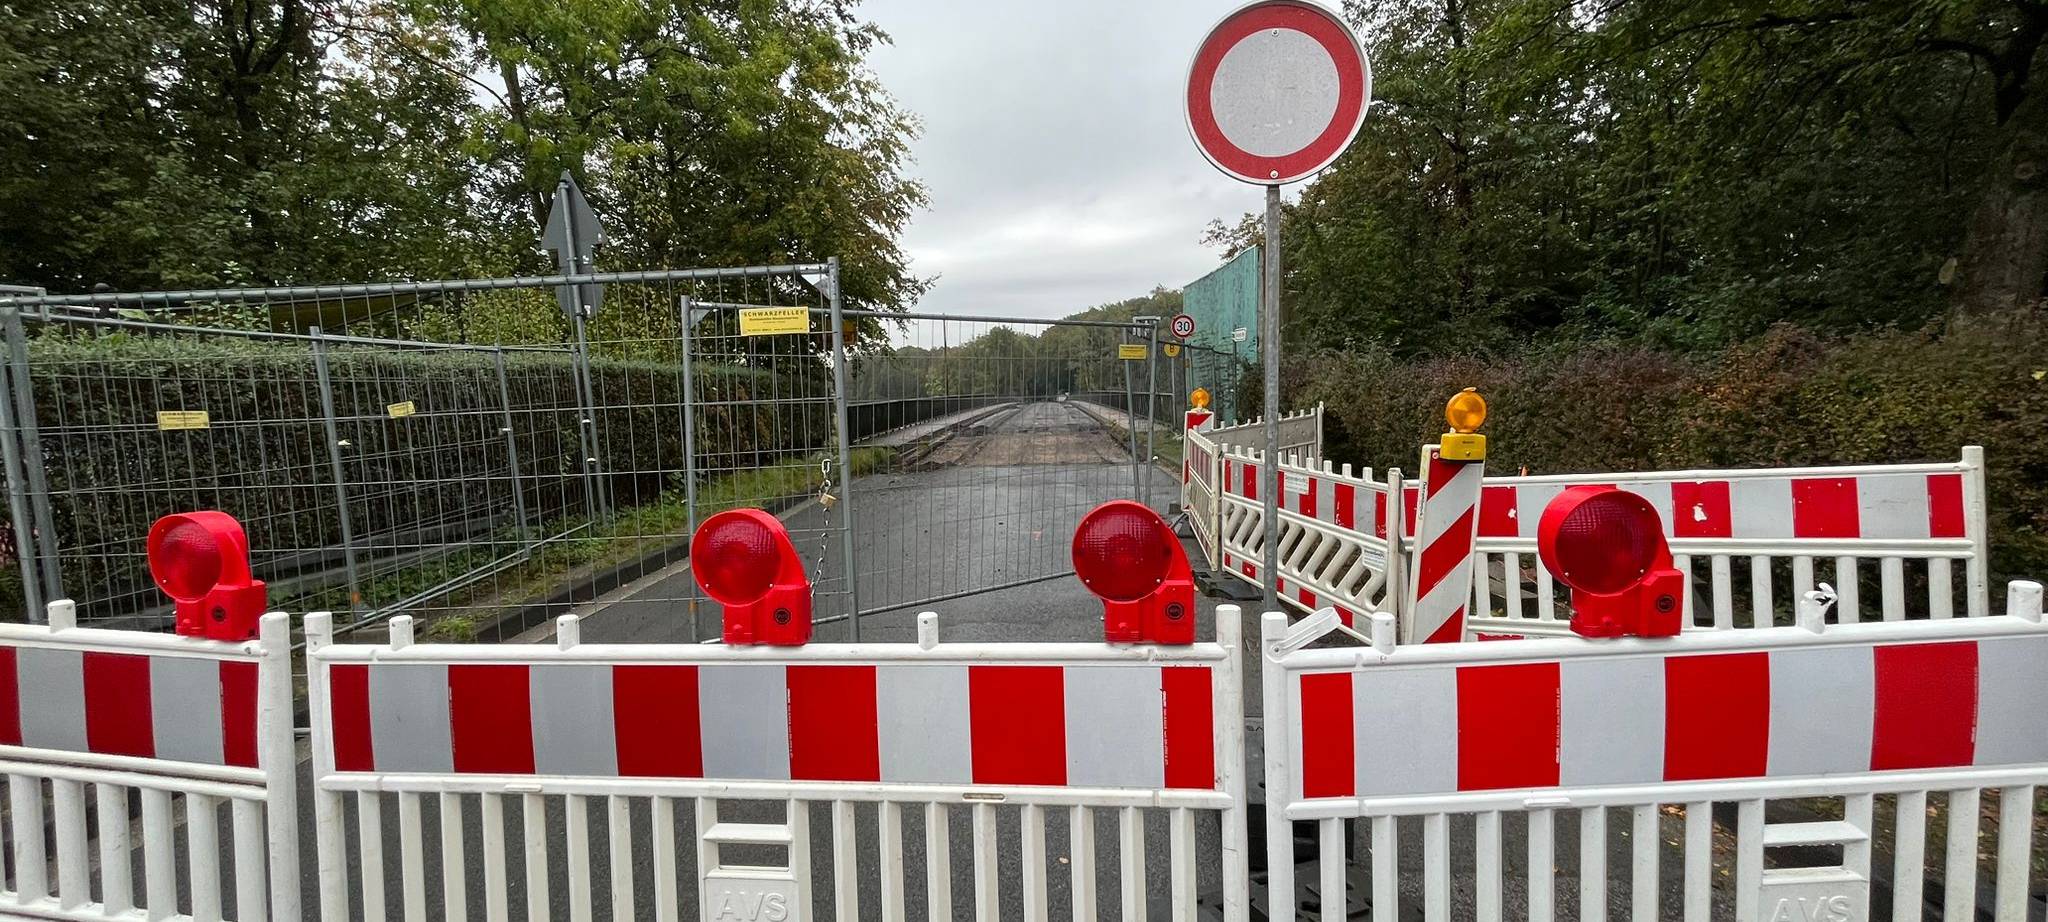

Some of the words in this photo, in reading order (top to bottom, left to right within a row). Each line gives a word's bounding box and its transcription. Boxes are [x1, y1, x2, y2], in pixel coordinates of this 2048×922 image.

[1176, 321, 1190, 332] 30
[716, 891, 788, 922] AVS
[1771, 895, 1853, 922] AVS
